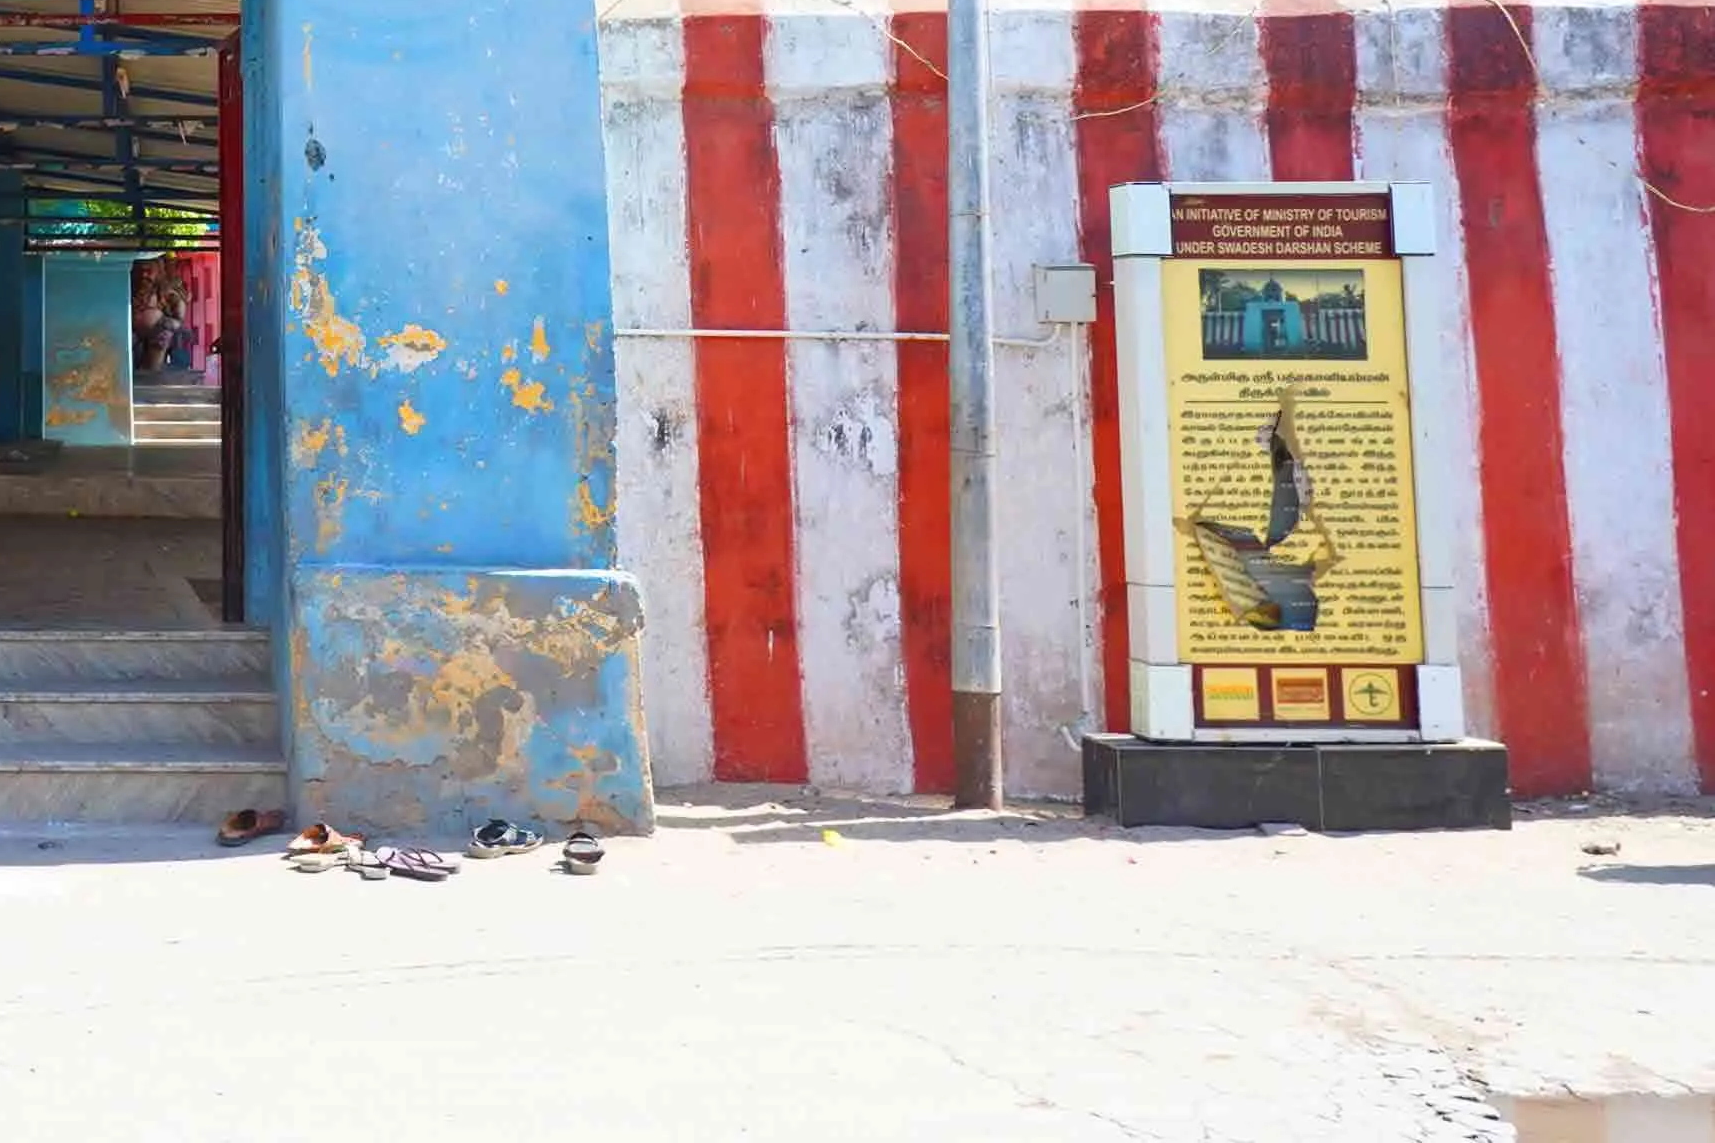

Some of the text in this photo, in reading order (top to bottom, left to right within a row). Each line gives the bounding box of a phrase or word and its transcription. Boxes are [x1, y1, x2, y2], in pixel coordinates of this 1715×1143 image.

[1186, 208, 1242, 220] INITIATIVE
[1244, 208, 1260, 220] OF
[1263, 208, 1315, 220] MINISTRY
[1317, 208, 1334, 220] OF
[1337, 208, 1387, 221] TOURISM
[1212, 225, 1343, 238] GOVERNMENT OF INDIA
[1176, 241, 1382, 254] UNDER SWADESH DARSHAN SCHEME
